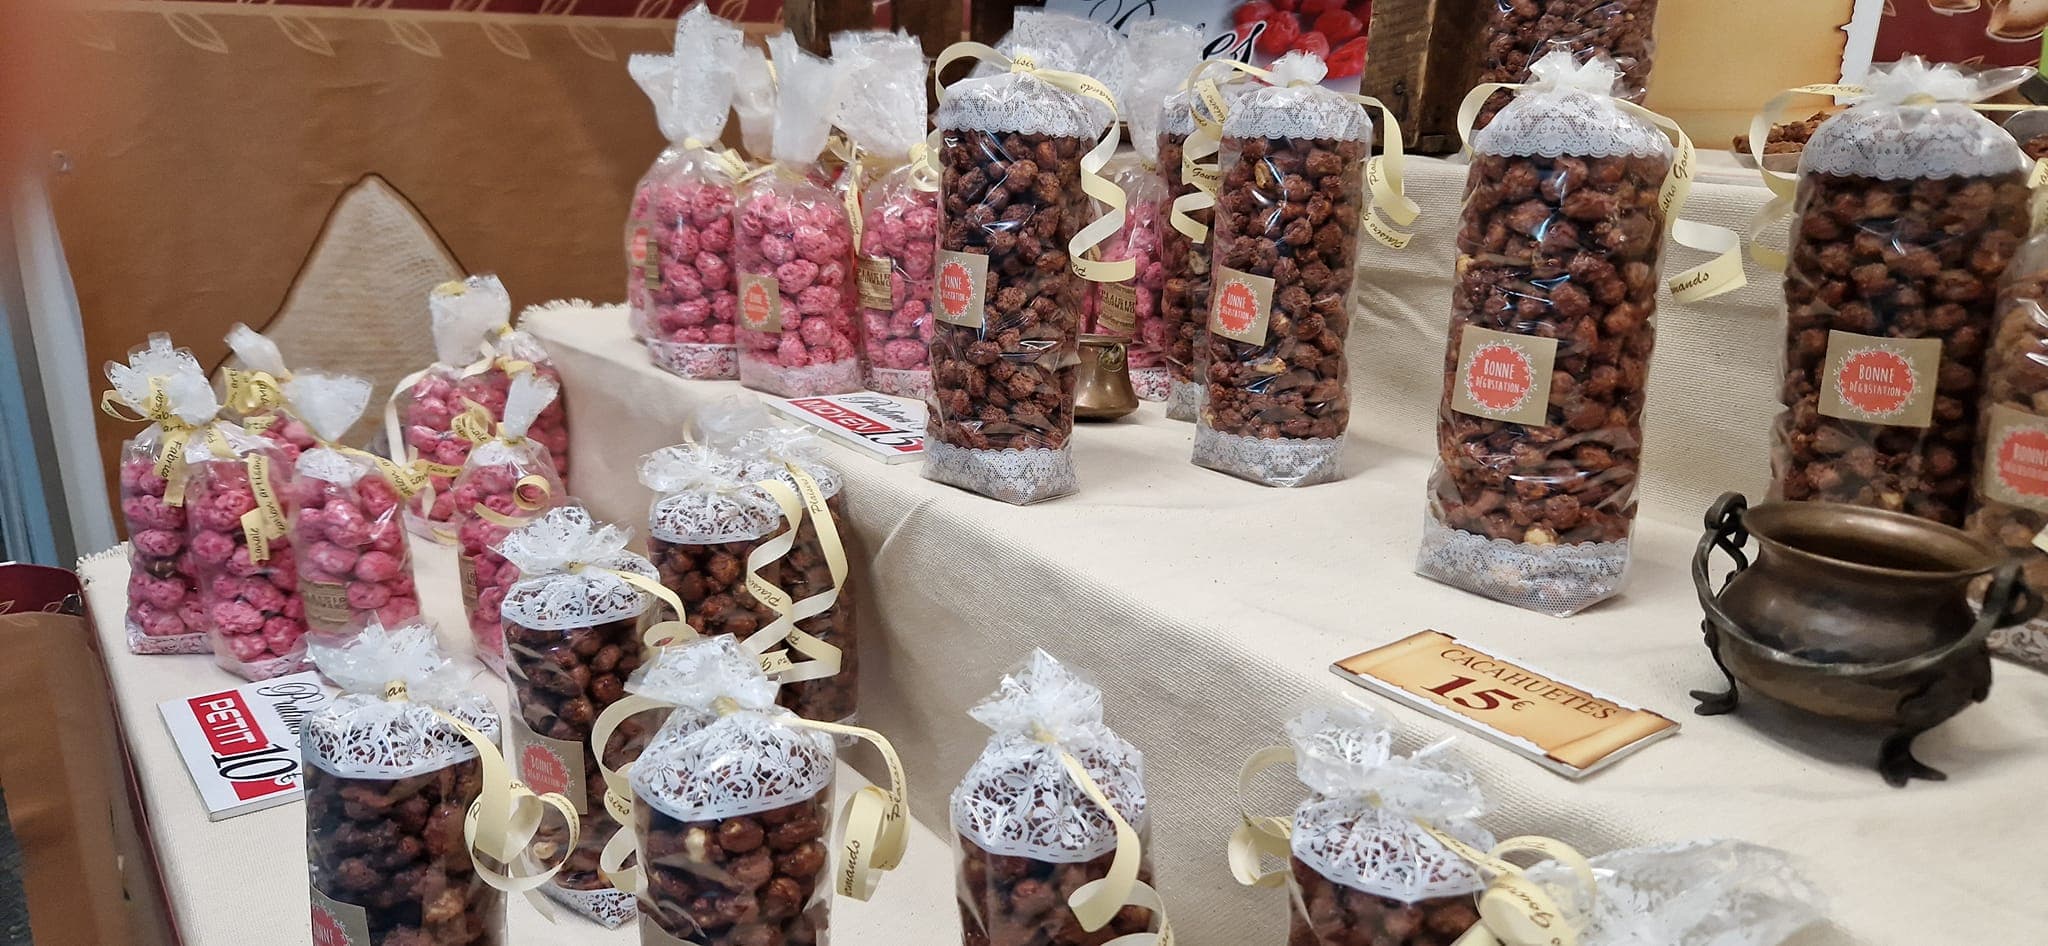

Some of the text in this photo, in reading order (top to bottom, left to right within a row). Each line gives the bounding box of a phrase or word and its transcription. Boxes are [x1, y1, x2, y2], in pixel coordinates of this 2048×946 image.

[1226, 293, 1247, 309] BONNE
[1484, 358, 1516, 380] BONNE
[1858, 363, 1896, 384] BONNE
[800, 400, 881, 431] MOYEN
[1420, 673, 1535, 713] 15€
[1440, 648, 1618, 721] CACAHUETES
[200, 697, 257, 746] PETIT
